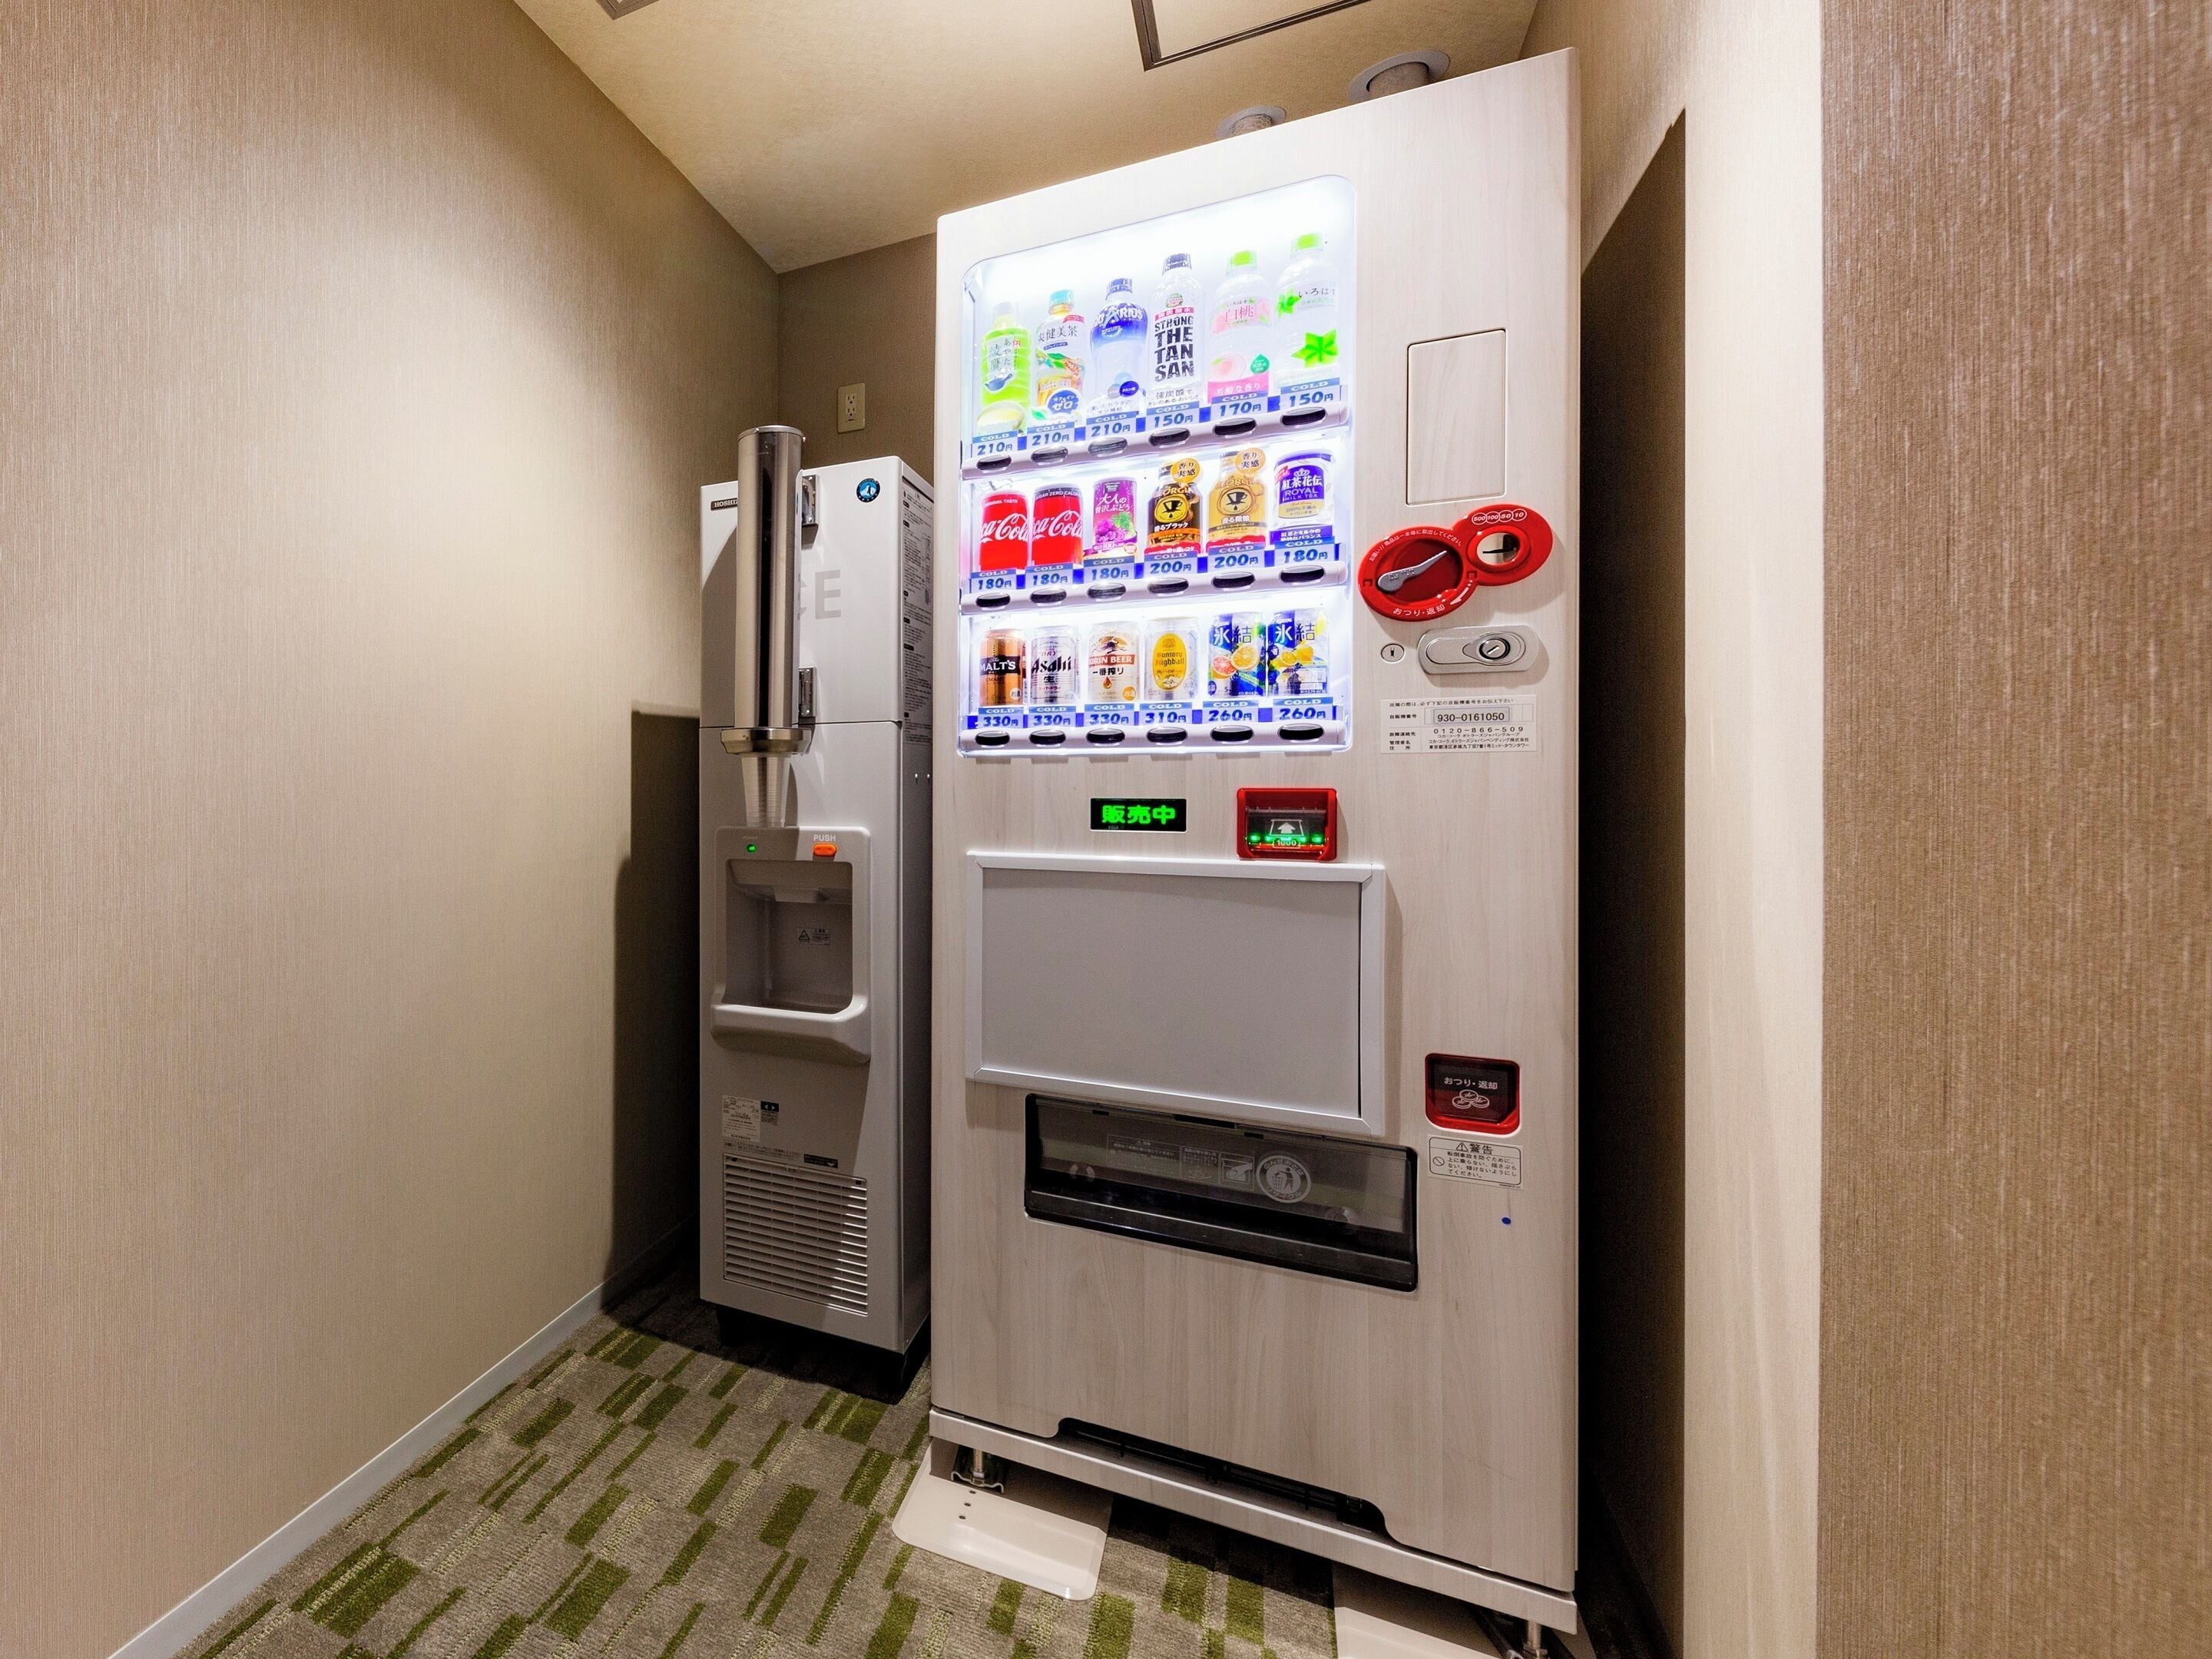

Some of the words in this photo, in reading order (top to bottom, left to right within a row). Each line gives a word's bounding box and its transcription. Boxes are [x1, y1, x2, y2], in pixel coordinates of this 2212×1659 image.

[1225, 305, 1254, 322] 白桃
[1154, 316, 1194, 332] STRONG
[1154, 326, 1194, 348] THE
[1154, 343, 1194, 365] TAN
[1154, 361, 1194, 382] SAN
[1290, 381, 1329, 392] COLD
[1222, 392, 1257, 402] COLD
[1289, 391, 1333, 407] 150円
[1155, 404, 1190, 413] COLD
[1220, 402, 1261, 417] 170円
[1095, 414, 1128, 422] COLD
[1154, 413, 1193, 428] 150円
[1036, 423, 1067, 432] COLD
[1091, 422, 1131, 437] 210円
[981, 432, 1010, 441] COLD
[1032, 432, 1069, 446] 210円
[978, 442, 1012, 455] 210円
[1243, 452, 1257, 460] 香り
[1241, 459, 1260, 469] 実感
[1177, 469, 1196, 477] 実感
[1281, 475, 1323, 491] 紅茶花伝
[1284, 487, 1318, 497] ROYAL
[1098, 493, 1127, 506] 大人の
[1154, 522, 1188, 533] 香るブラック
[1214, 554, 1258, 568] 200円
[1284, 548, 1328, 564] 180円
[1091, 567, 1129, 581] 180円
[1150, 561, 1191, 575] 200円
[979, 578, 1012, 590] 180円
[1032, 573, 1068, 585] 180円
[1392, 604, 1446, 617] おつり・返却
[1214, 625, 1252, 646] 氷結
[1275, 622, 1316, 644] 氷結
[980, 660, 1016, 672] MALT'S
[1031, 655, 1071, 674] Asahi
[1155, 658, 1184, 667] Highball
[1092, 667, 1124, 676] 一番搾り
[1044, 675, 1055, 684] 生
[1090, 713, 1129, 725] 330円
[1145, 711, 1187, 724] 310円
[1208, 709, 1252, 722] 260円
[1279, 707, 1326, 720] 260円
[1437, 712, 1505, 723] 930-0161050
[983, 716, 1018, 727] 330円
[1033, 714, 1071, 727] 330円
[1101, 804, 1176, 825] 販売中
[1443, 1077, 1498, 1090] おつり・返却
[1469, 1144, 1493, 1155] 警告
[1449, 1169, 1482, 1178] てください。
